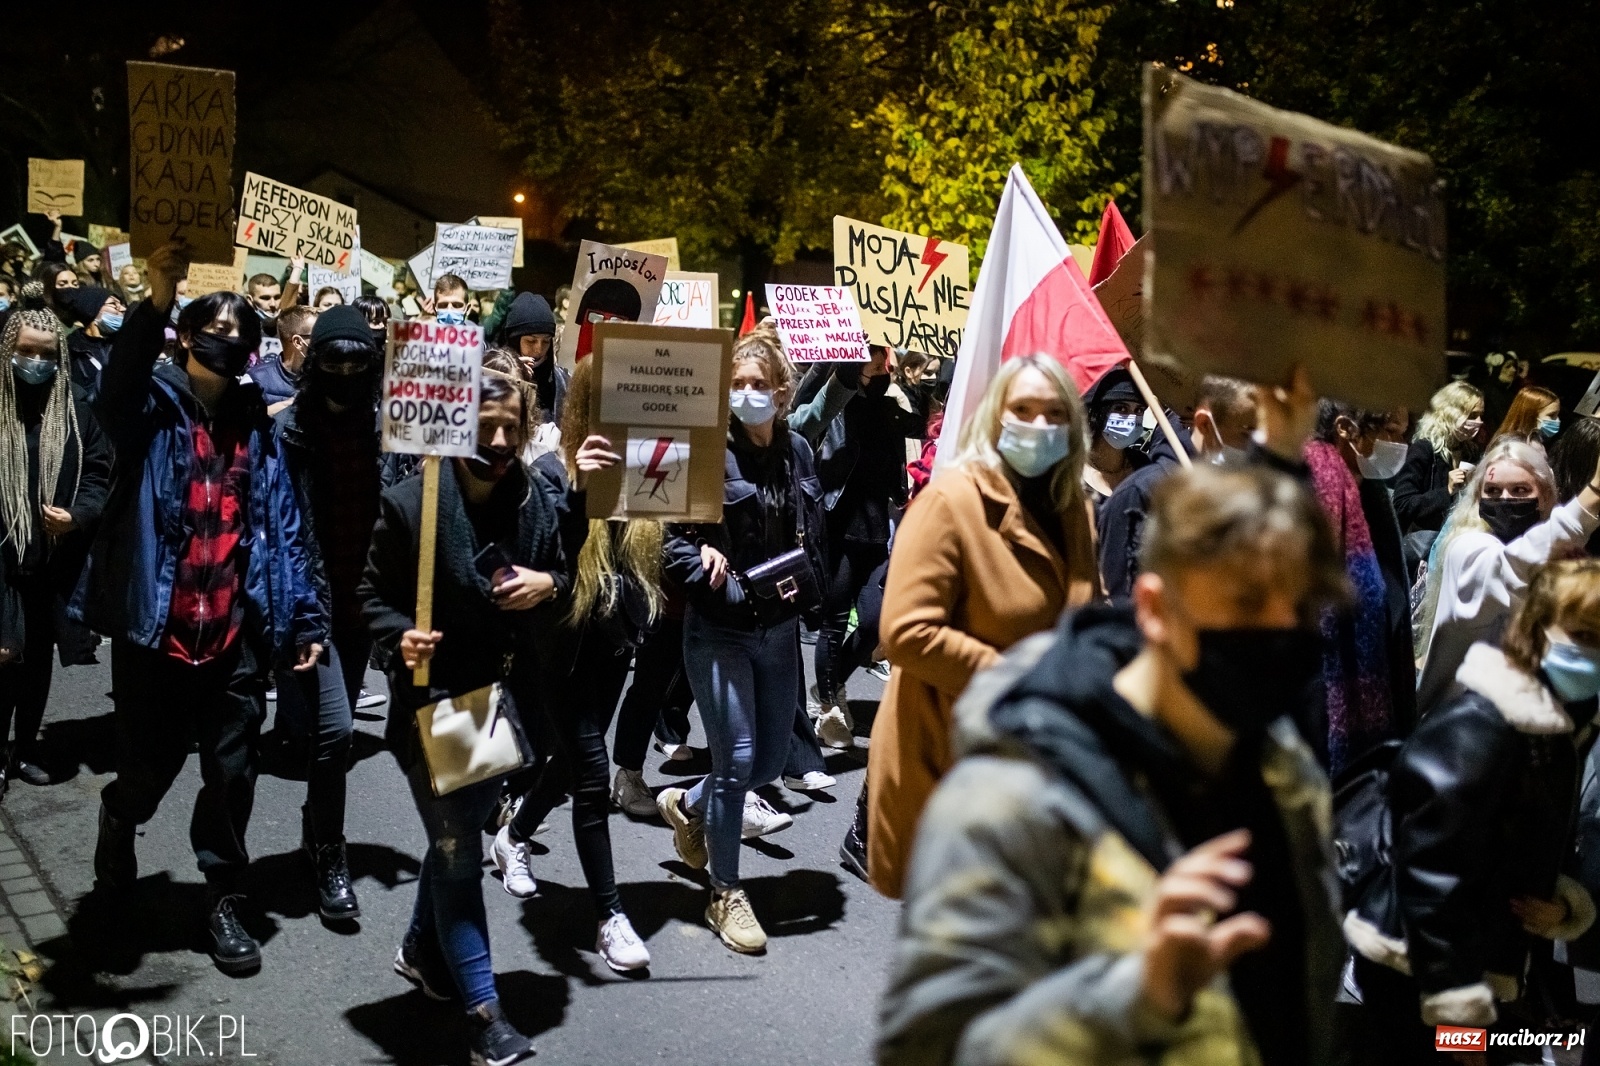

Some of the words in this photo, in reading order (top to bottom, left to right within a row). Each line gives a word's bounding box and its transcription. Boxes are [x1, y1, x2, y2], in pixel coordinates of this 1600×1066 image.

[132, 121, 228, 158] GDYNIA
[134, 154, 216, 193] KAJA
[133, 195, 233, 232] GODEK
[246, 176, 330, 221] MEFEDRON
[336, 209, 354, 230] MA
[241, 197, 302, 233] LEPSZY
[307, 221, 353, 249] SKŁAD
[257, 227, 287, 252] NIŻ
[849, 224, 920, 276] MOJA
[587, 252, 657, 282] Impostor
[657, 282, 710, 320] ORCJA?
[775, 286, 819, 301] GODEK
[824, 287, 843, 300] TY
[933, 274, 970, 315] NIE
[780, 316, 830, 329] PRZESTAŃ
[838, 318, 852, 327] MI
[883, 316, 965, 358] JARUSI
[393, 342, 451, 363] KOCHAM
[461, 349, 466, 364] I
[655, 348, 670, 357] NA
[391, 361, 472, 383] ROZUMIEM
[630, 365, 693, 377] HALLOWEEN
[616, 383, 672, 396] PRZEBIORĘ
[674, 385, 689, 397] SIĘ
[691, 386, 705, 396] ZA
[390, 400, 468, 426] ODDAĆ
[642, 402, 677, 412] GODEK
[389, 424, 413, 441] NIE
[423, 427, 472, 446] UMIEM
